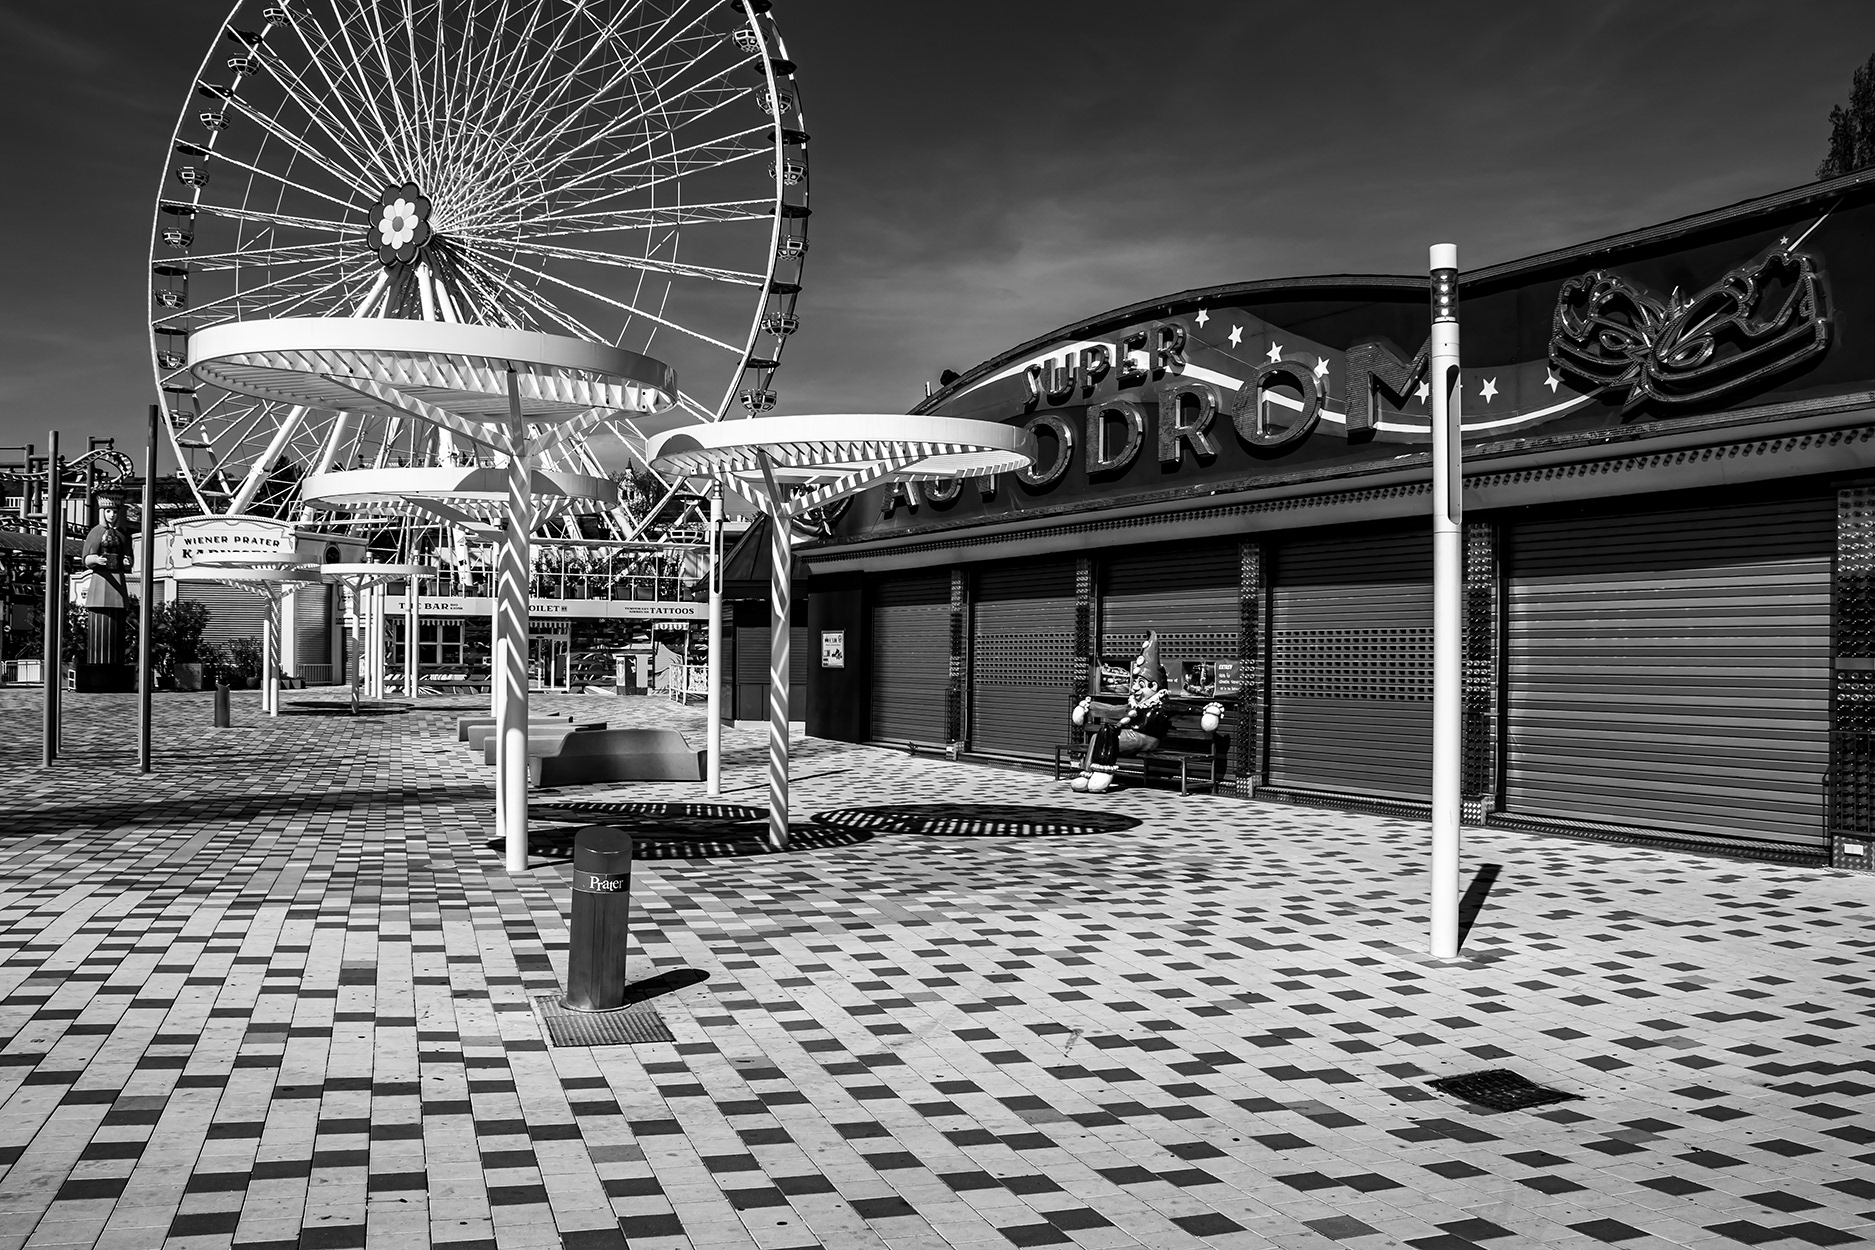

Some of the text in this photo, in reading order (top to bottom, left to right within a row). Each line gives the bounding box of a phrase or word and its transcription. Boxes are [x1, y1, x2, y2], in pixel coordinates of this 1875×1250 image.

[1022, 323, 1188, 407] SUPER
[184, 535, 280, 548] WIENER PRATER
[424, 602, 449, 610] BAR
[528, 604, 560, 612] OILET
[650, 607, 695, 615] TATTOOS
[589, 875, 624, 892] Prater
